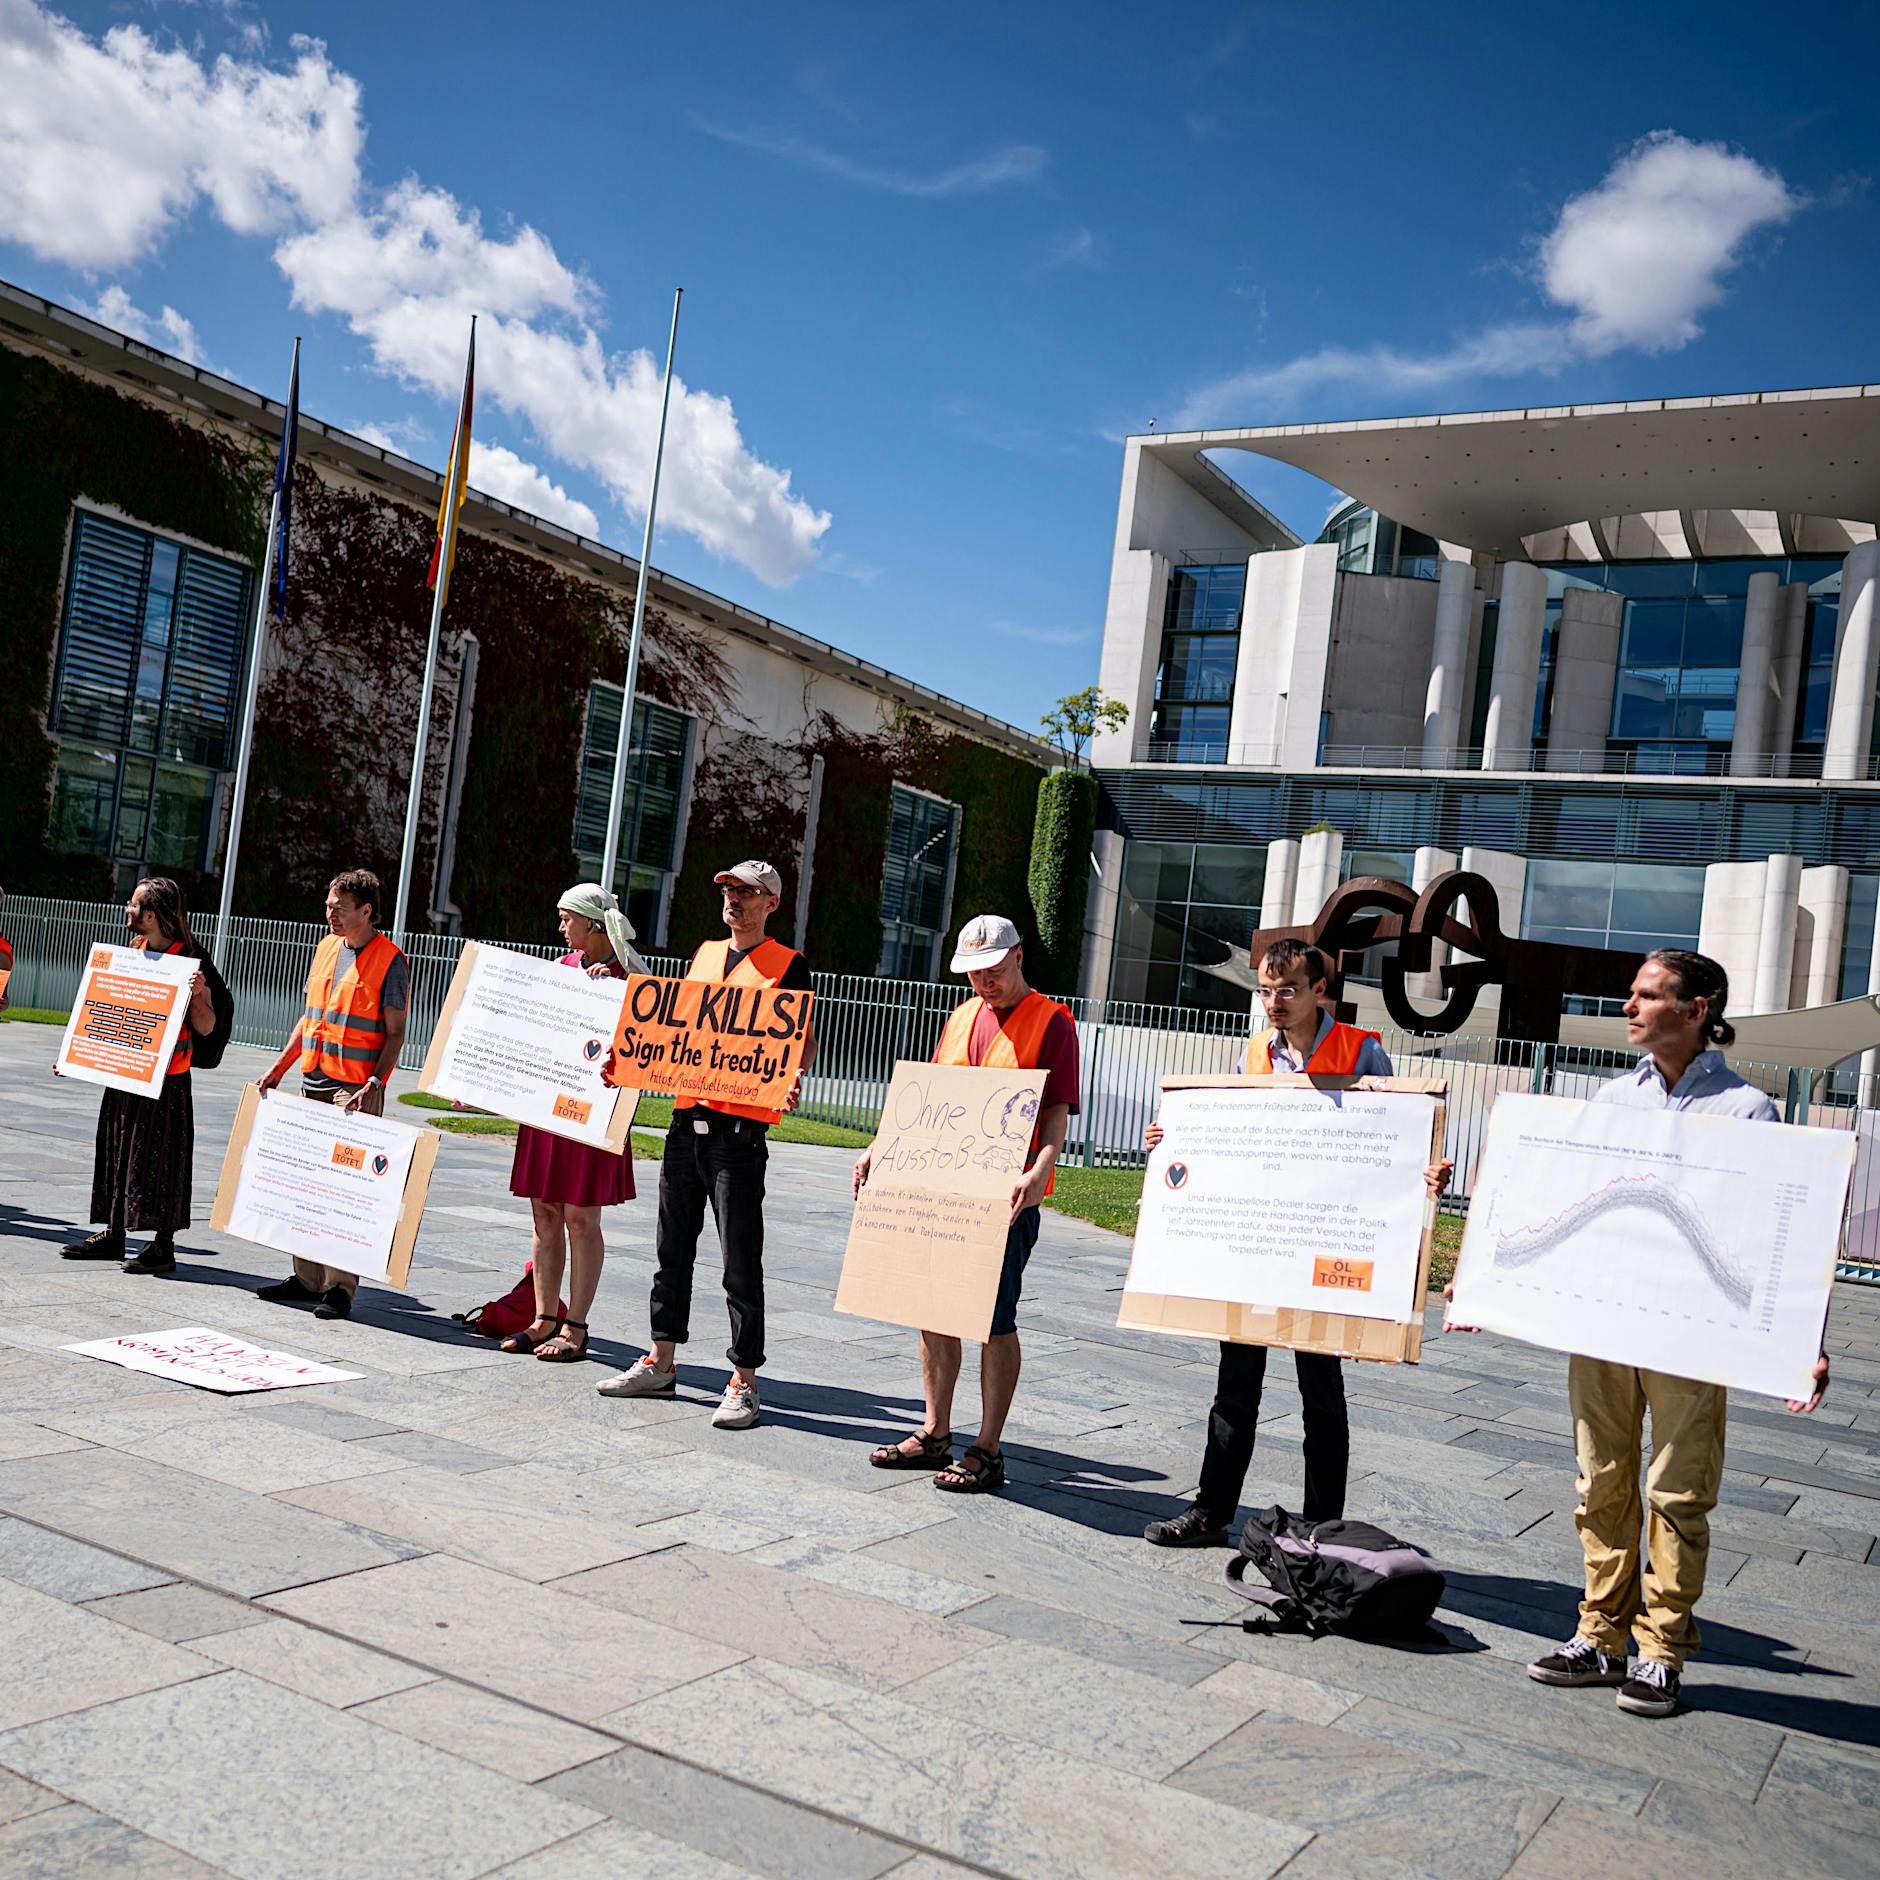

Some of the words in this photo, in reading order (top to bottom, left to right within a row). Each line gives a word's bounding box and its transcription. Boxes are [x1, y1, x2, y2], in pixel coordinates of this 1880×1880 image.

[481, 1003, 507, 1015] Privilegien
[497, 999, 528, 1012] Geschichte
[565, 1018, 578, 1027] dass
[579, 1022, 611, 1035] Privilegierte
[565, 1009, 582, 1019] lange
[632, 979, 687, 1028] OIL
[696, 984, 810, 1041] KILLS!
[501, 1035, 513, 1043] dass
[483, 1047, 494, 1055] ihm
[504, 1054, 524, 1064] seinem
[524, 1060, 550, 1072] Gewissen
[551, 1069, 580, 1080] ungerecht
[504, 1045, 518, 1053] dem
[518, 1049, 537, 1060] Gesetz
[573, 1065, 592, 1076] Gesetz
[618, 1027, 664, 1070] Sign
[670, 1031, 702, 1067] the
[710, 1039, 791, 1084] treaty!
[487, 1067, 499, 1075] und
[488, 1058, 505, 1067] damit
[505, 1063, 515, 1071] das
[516, 1066, 542, 1079] Gewissen
[542, 1075, 559, 1083] seiner
[559, 1079, 586, 1092] Mitbürger
[568, 1098, 578, 1109] ÖL
[895, 1079, 967, 1131] Ohne
[1264, 1101, 1299, 1114] Frühjahr
[1350, 1105, 1361, 1113] ihr
[1364, 1106, 1387, 1115] wollt
[558, 1105, 585, 1122] TÖTET
[1176, 1124, 1189, 1133] Wie
[1190, 1125, 1203, 1133] ein
[1204, 1125, 1230, 1134] Junkie
[1232, 1125, 1247, 1134] auf
[1248, 1126, 1263, 1135] der
[1265, 1126, 1290, 1136] Suche
[1295, 1127, 1319, 1137] nach
[1322, 1128, 1344, 1138] Stoff
[1346, 1130, 1382, 1140] bohren
[1385, 1132, 1399, 1141] wir
[344, 1146, 354, 1156] ÖL
[1204, 1137, 1231, 1145] tiefere
[1233, 1137, 1262, 1146] Löcher
[1264, 1138, 1272, 1146] in
[1274, 1138, 1289, 1147] die
[1317, 1141, 1333, 1149] um
[1336, 1140, 1361, 1150] noch
[1364, 1142, 1390, 1152] mehr
[335, 1152, 360, 1167] TÖTET
[1189, 1148, 1209, 1156] dem
[1291, 1152, 1323, 1161] wovon
[1325, 1153, 1339, 1162] wir
[1342, 1153, 1392, 1168] abhängig
[938, 1197, 957, 1207] sitzen
[958, 1200, 976, 1209] nicht
[979, 1203, 992, 1215] auf
[1188, 1194, 1205, 1202] Und
[1207, 1195, 1221, 1203] wie
[1223, 1195, 1270, 1207] skrupellose
[1273, 1198, 1304, 1209] Dealer
[1306, 1201, 1339, 1213] sorgen
[1342, 1203, 1358, 1214] die
[942, 1214, 970, 1225] sondern
[973, 1219, 982, 1230] in
[1162, 1204, 1229, 1216] Energiekonzerne
[1231, 1207, 1248, 1217] und
[1250, 1208, 1267, 1218] ihre
[1270, 1209, 1326, 1225] Handlanger
[1328, 1213, 1337, 1224] in
[1339, 1215, 1357, 1226] der
[1359, 1216, 1388, 1230] Politik
[904, 1224, 916, 1234] und
[920, 1226, 966, 1243] Parlamenten
[1168, 1216, 1181, 1225] seit
[1183, 1217, 1235, 1229] Jahrzehnten
[1265, 1221, 1286, 1232] dass
[1288, 1222, 1313, 1235] jeder
[1316, 1225, 1355, 1239] Versuch
[1358, 1230, 1377, 1241] der
[1166, 1228, 1219, 1241] Entwöhnung
[1221, 1232, 1237, 1240] von
[1239, 1232, 1254, 1241] der
[1256, 1233, 1277, 1243] alles
[1278, 1234, 1341, 1250] zerstörenden
[1343, 1239, 1375, 1253] Nadel
[1229, 1244, 1273, 1257] torpediert
[1334, 1259, 1352, 1273] ÖL
[1320, 1270, 1366, 1288] TÖTET
